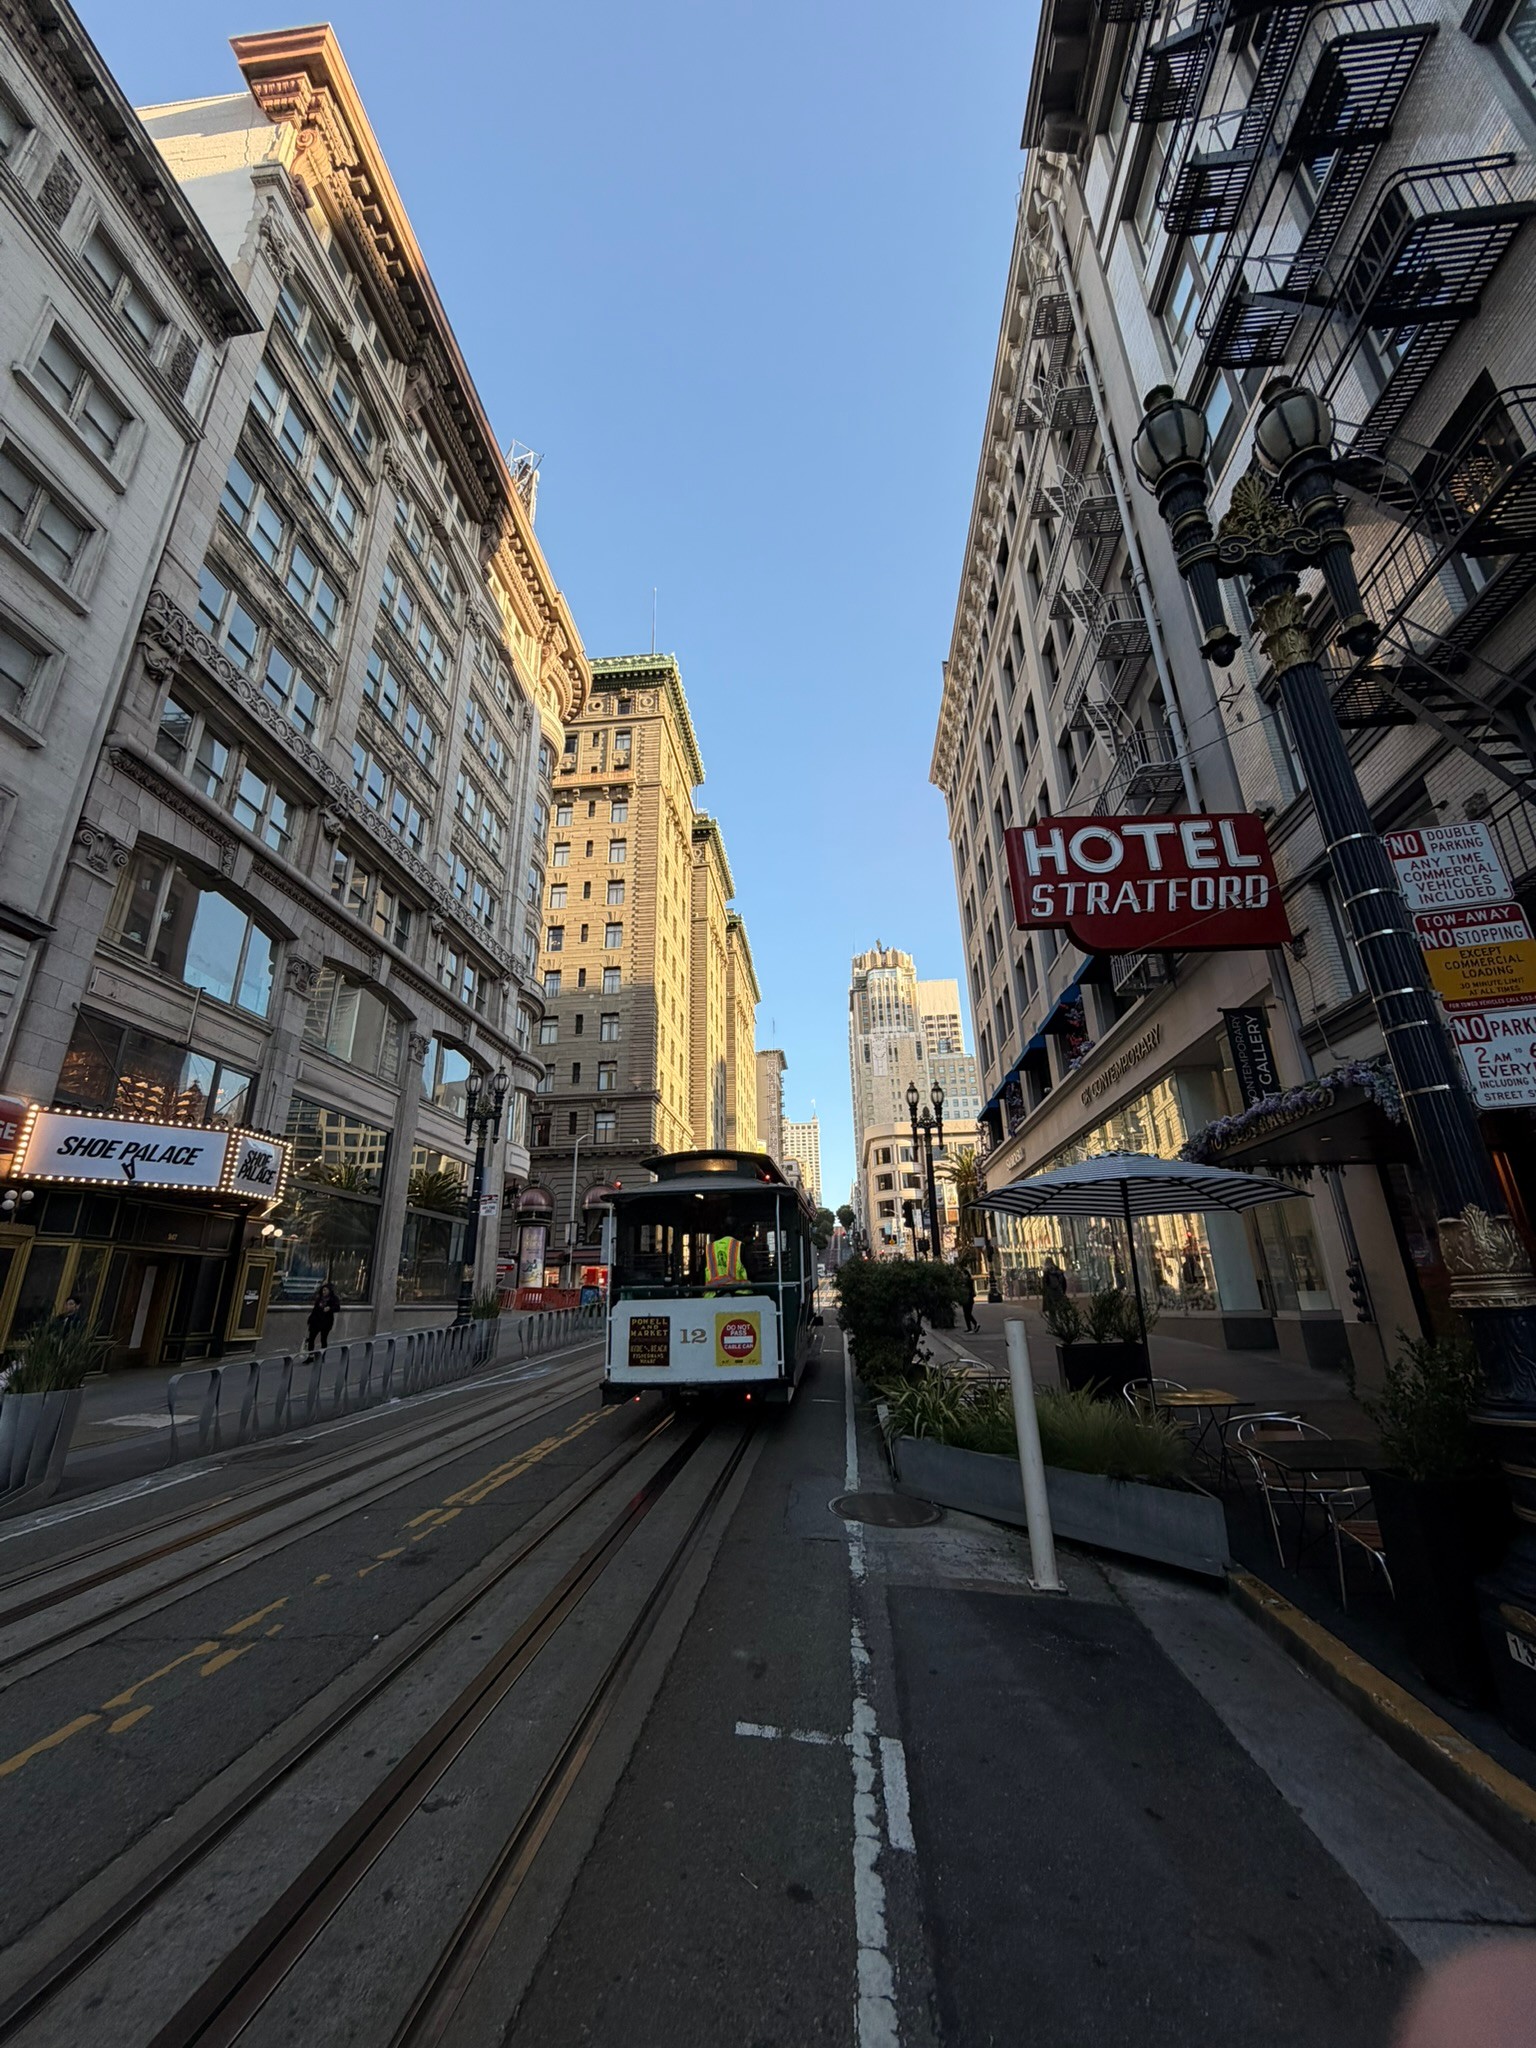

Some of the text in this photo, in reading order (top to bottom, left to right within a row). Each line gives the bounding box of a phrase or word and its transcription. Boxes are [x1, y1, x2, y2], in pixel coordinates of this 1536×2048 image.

[1426, 825, 1479, 841] DOUBLE
[1022, 819, 1262, 877] HOTEL
[1389, 834, 1419, 856] NO
[1430, 837, 1484, 853] PARKING
[1410, 852, 1484, 871] ANY TIME
[1403, 862, 1498, 883] COMMERCIAL
[1415, 874, 1492, 892] VEHICLES
[1031, 875, 1269, 917] STRATFORD
[1418, 886, 1496, 904] INCLUDED
[1422, 907, 1510, 928] TOW-AWAY
[1422, 924, 1523, 949] NO STOPPING
[1444, 953, 1525, 970] COMMERCIAL
[1459, 946, 1502, 959] EXCEPT
[1462, 965, 1514, 979] LOADING
[1472, 979, 1503, 988] MINUTE
[1480, 987, 1496, 995] ALL
[1497, 985, 1520, 993] TIMES
[1505, 996, 1520, 1004] CALL
[1454, 1016, 1487, 1041] NO
[1244, 1014, 1273, 1085] GALLERY
[1474, 1046, 1490, 1064] 2
[1494, 1052, 1512, 1063] AM
[1091, 1023, 1161, 1097] CONTEMPORARY
[1478, 1061, 1536, 1078] EVERY
[1479, 1076, 1530, 1089] INCLUDING
[1484, 1090, 1523, 1101] STREET
[56, 1136, 204, 1167] SHOE PALACE
[244, 1149, 273, 1167] SHOE
[237, 1163, 277, 1185] PALACE
[630, 1329, 668, 1337] MARKET
[680, 1328, 708, 1344] 12
